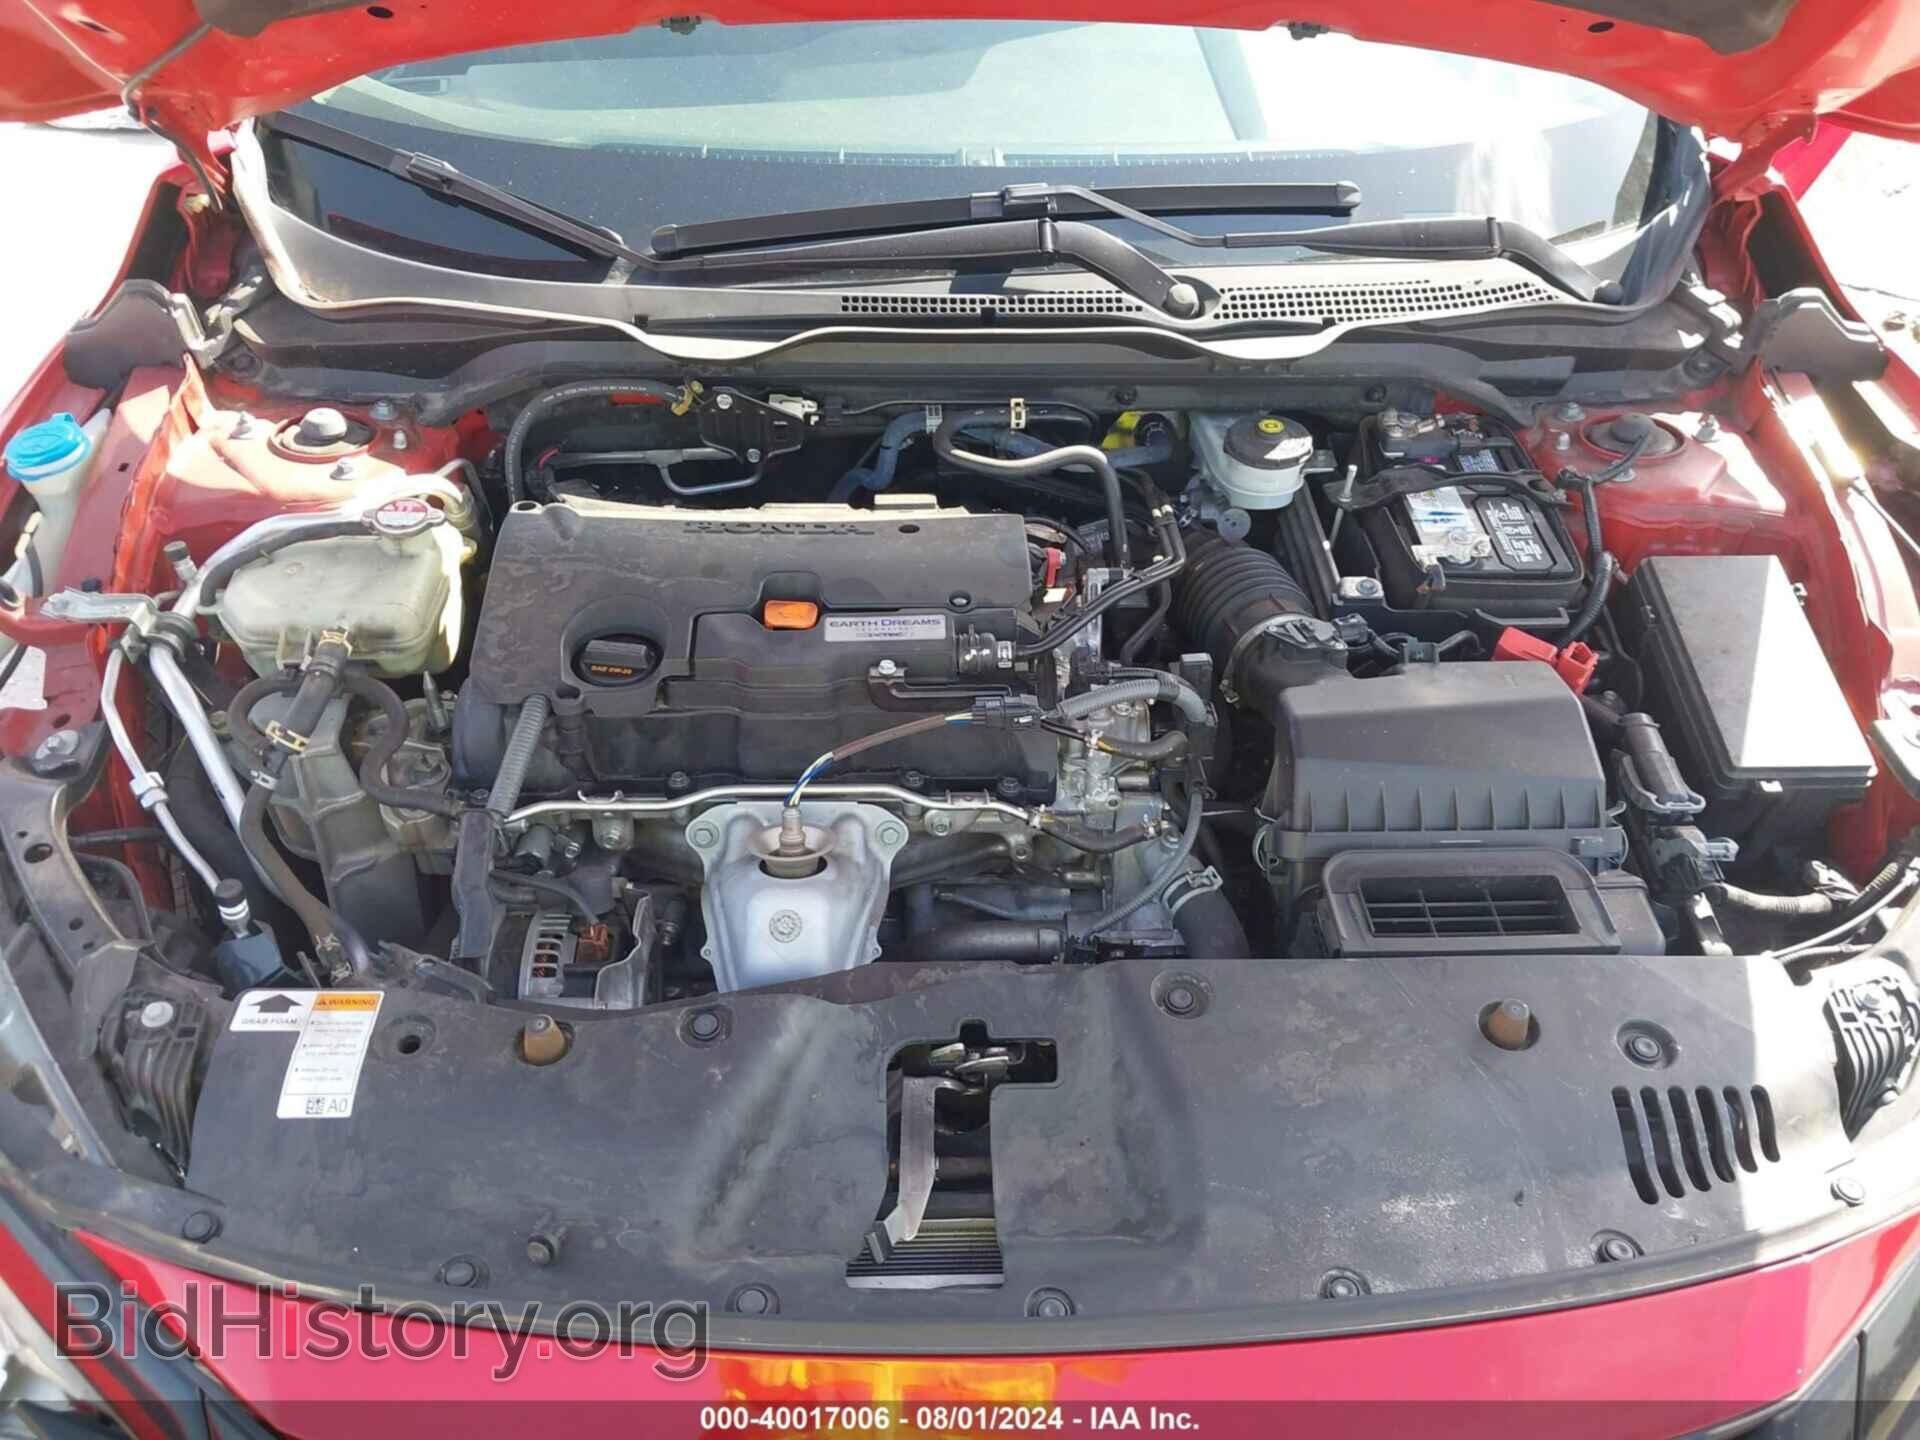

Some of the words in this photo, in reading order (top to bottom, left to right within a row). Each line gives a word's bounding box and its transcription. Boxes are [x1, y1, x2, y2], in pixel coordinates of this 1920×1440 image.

[829, 620, 878, 628] EARTH
[881, 618, 941, 627] DREAMS
[329, 998, 376, 1006] WARNING
[270, 1017, 298, 1025] FOAM
